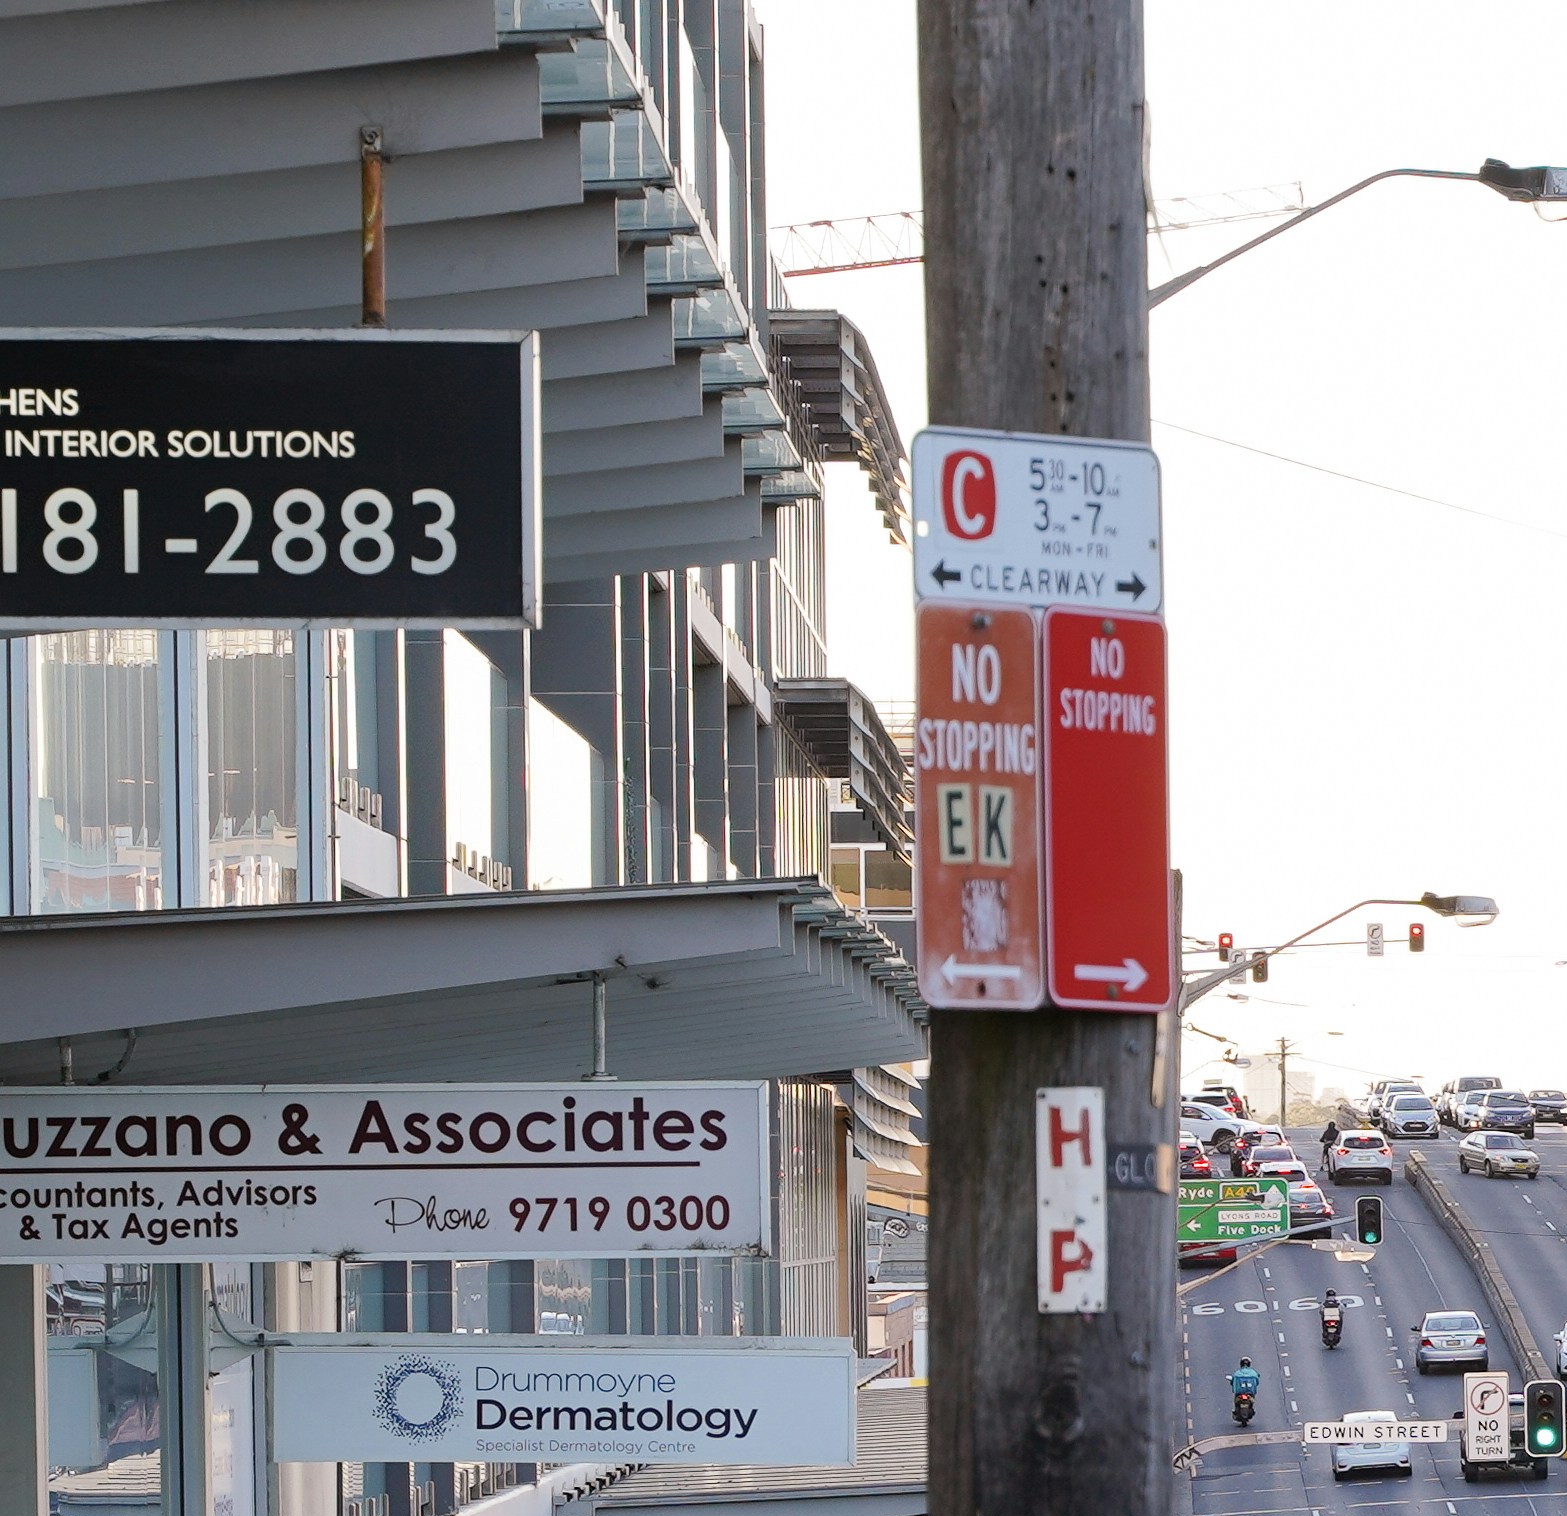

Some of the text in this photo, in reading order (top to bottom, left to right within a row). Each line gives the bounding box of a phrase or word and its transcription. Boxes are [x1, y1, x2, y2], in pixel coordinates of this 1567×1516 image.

[5, 429, 356, 459] INTERIOR SOLUTIONS
[952, 456, 985, 535] C
[1, 487, 457, 575] 181-2883
[970, 564, 1105, 597] CLEARWAY
[1090, 636, 1125, 680] NO
[952, 643, 1001, 706] NO
[1060, 688, 1156, 736] STOPPING
[919, 717, 1037, 776] STOPPING
[3, 1096, 728, 1159] uzzano & Associates
[176, 1179, 318, 1207] Advisors
[1179, 1187, 1214, 1200] Ryde
[20, 1213, 240, 1245] & Tax Agents
[374, 1195, 730, 1234] Phone 9719 0300
[1218, 1225, 1282, 1235] Five Dock
[475, 1366, 676, 1397] Drummoyne
[476, 1399, 758, 1439] Dermatology
[1310, 1425, 1443, 1439] EDWIN STREET
[1478, 1420, 1499, 1431] NO
[476, 1439, 696, 1454] Specialist Dermatology Centre
[1476, 1434, 1501, 1444] RIGHT
[1476, 1446, 1503, 1455] TURN
